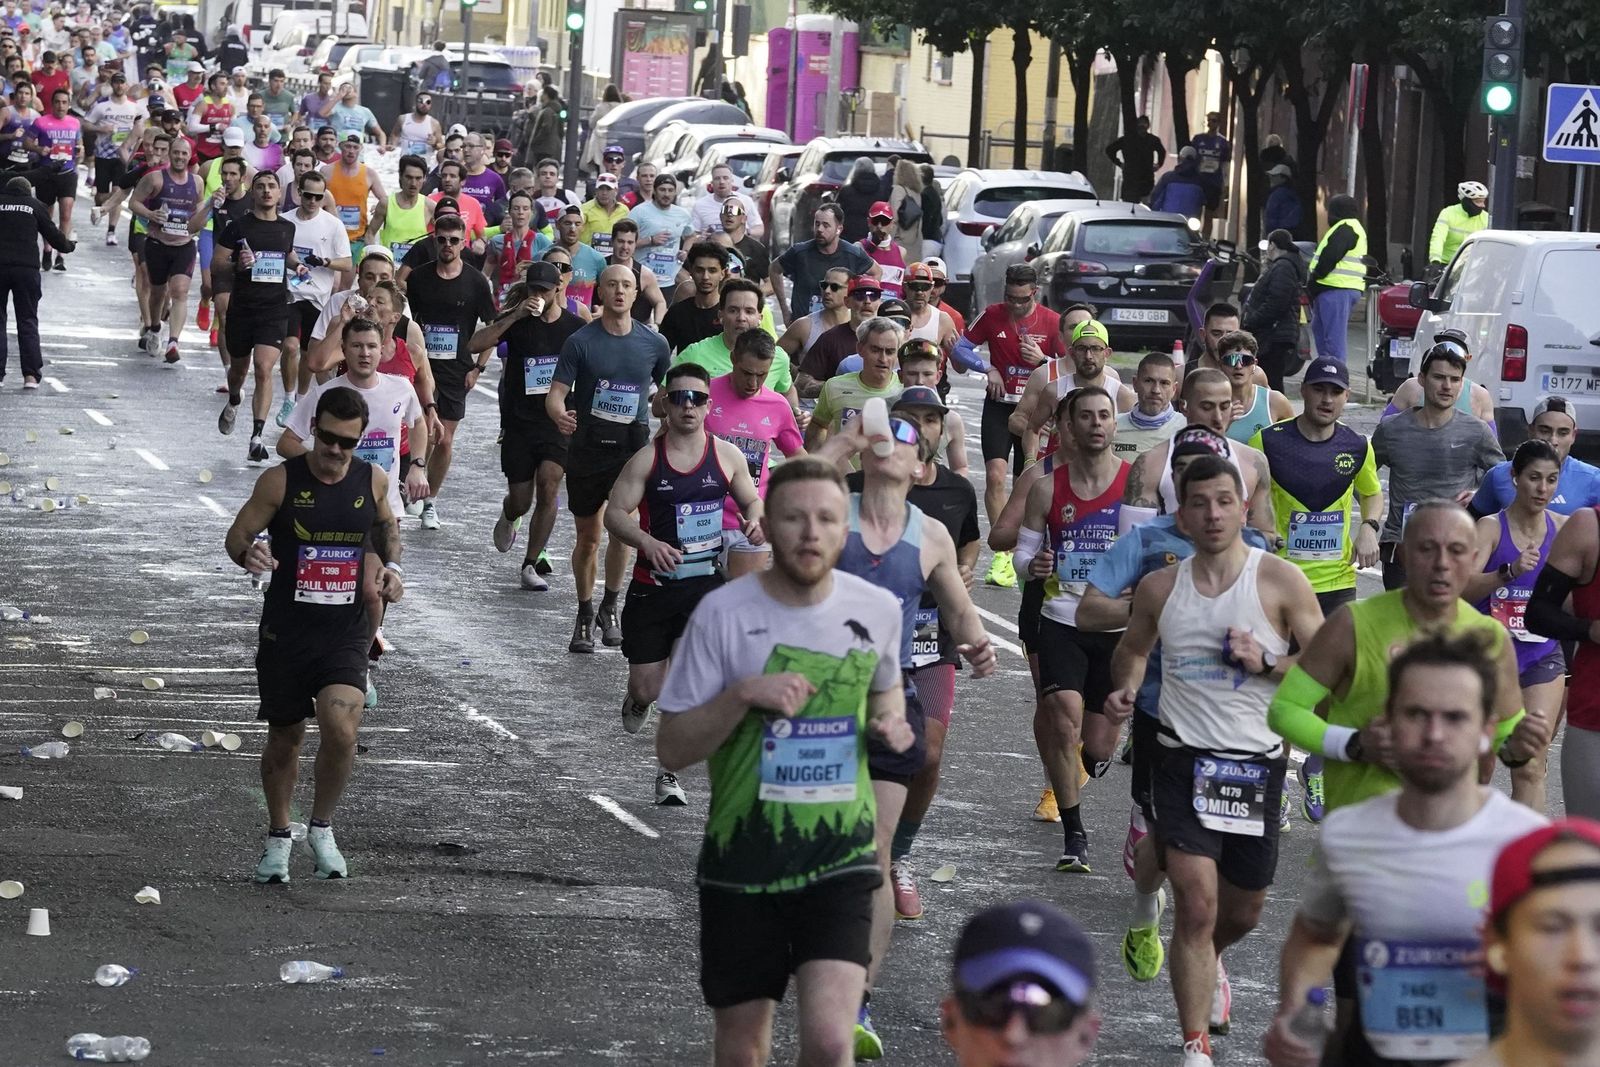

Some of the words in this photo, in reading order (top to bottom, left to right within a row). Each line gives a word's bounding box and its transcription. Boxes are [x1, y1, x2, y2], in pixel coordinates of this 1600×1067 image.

[1119, 310, 1144, 320] 4249
[1147, 311, 1166, 321] GBR
[536, 377, 552, 386] SOS
[1550, 377, 1582, 389] 9177
[598, 400, 633, 414] KRISTOF
[1339, 460, 1352, 468] ACV
[696, 503, 720, 512] ZURICH
[697, 519, 711, 527] 6324
[1310, 514, 1339, 522] ZURICH
[1062, 529, 1115, 540] PALACIEGO
[1078, 543, 1110, 551] ZURICH
[1295, 538, 1337, 550] QUENTIN
[321, 550, 355, 558] ZURICH
[321, 566, 340, 575] 1398
[297, 580, 323, 591] CALIL
[325, 580, 356, 591] VALOTO
[798, 721, 848, 735] ZURICH
[775, 763, 843, 783] NUGGET
[1221, 765, 1261, 778] ZURICH
[1219, 785, 1242, 798] 4179
[1208, 798, 1250, 818] MILOS
[1396, 1004, 1444, 1029] BEN
